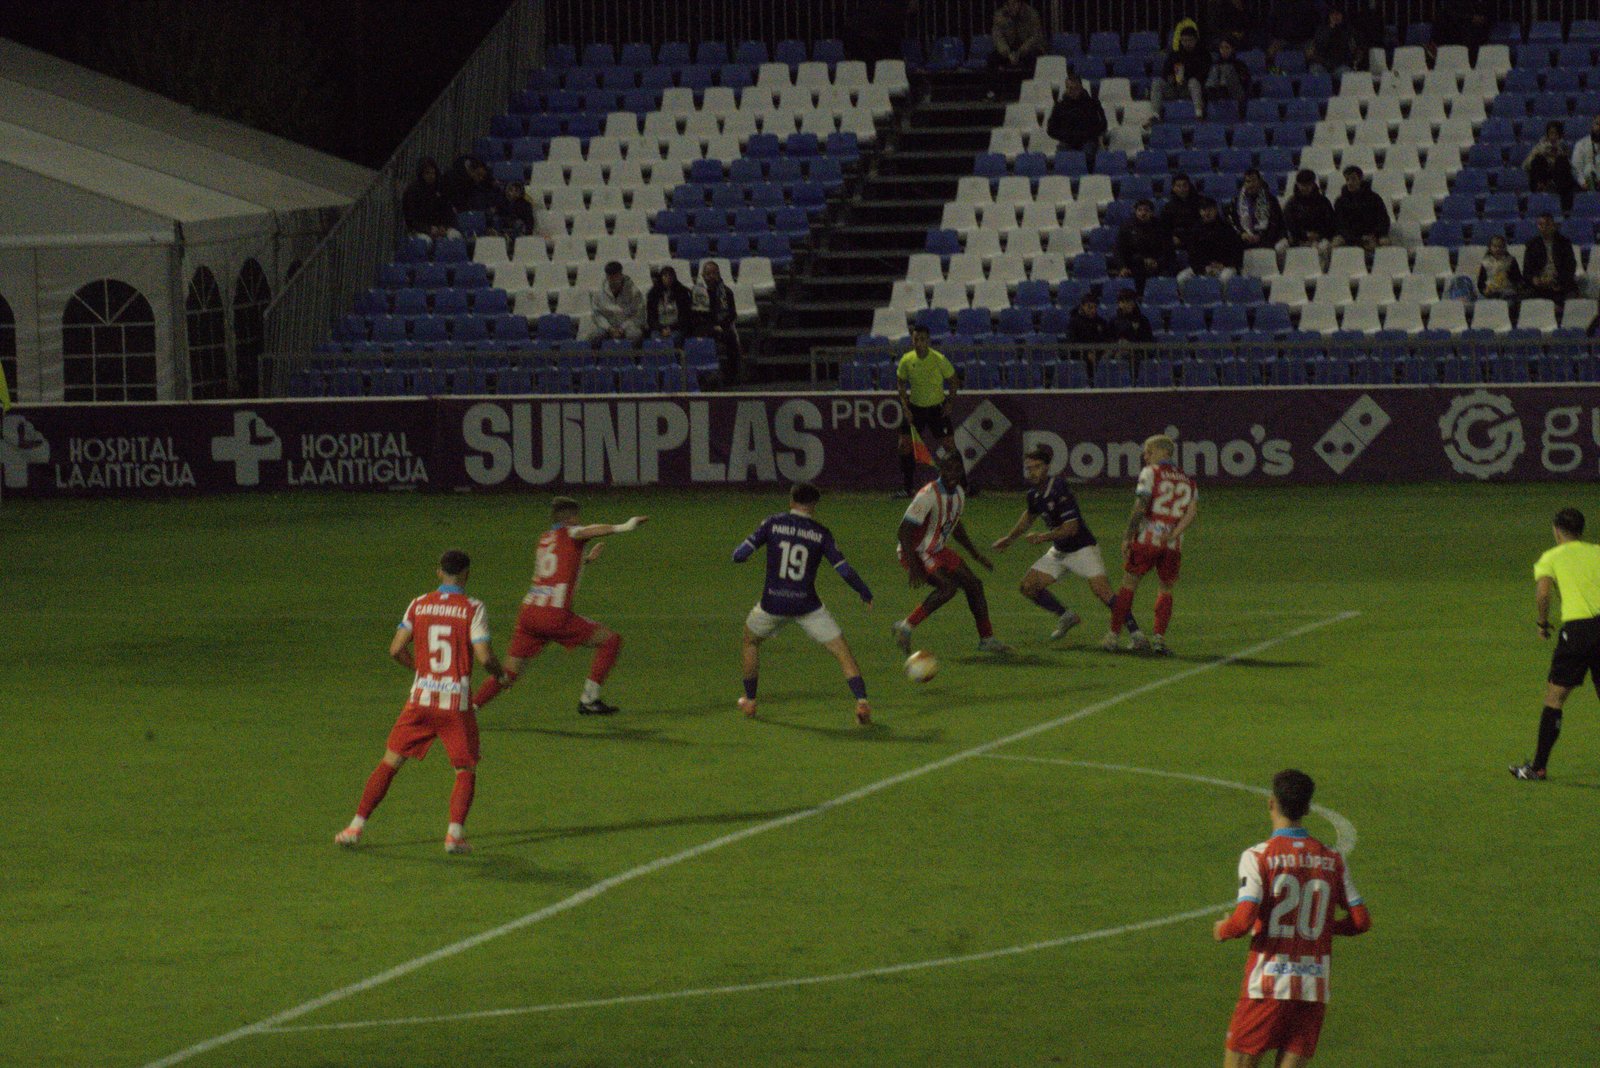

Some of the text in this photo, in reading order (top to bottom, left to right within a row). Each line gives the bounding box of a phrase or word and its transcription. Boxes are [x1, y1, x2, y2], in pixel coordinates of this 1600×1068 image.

[831, 399, 903, 429] PRO
[1541, 405, 1600, 474] g
[1152, 480, 1192, 518] 22
[535, 543, 559, 578] 6
[779, 540, 809, 581] 19
[427, 624, 453, 673] 5
[1298, 851, 1336, 872] LÓPEZ
[1267, 873, 1331, 941] 20
